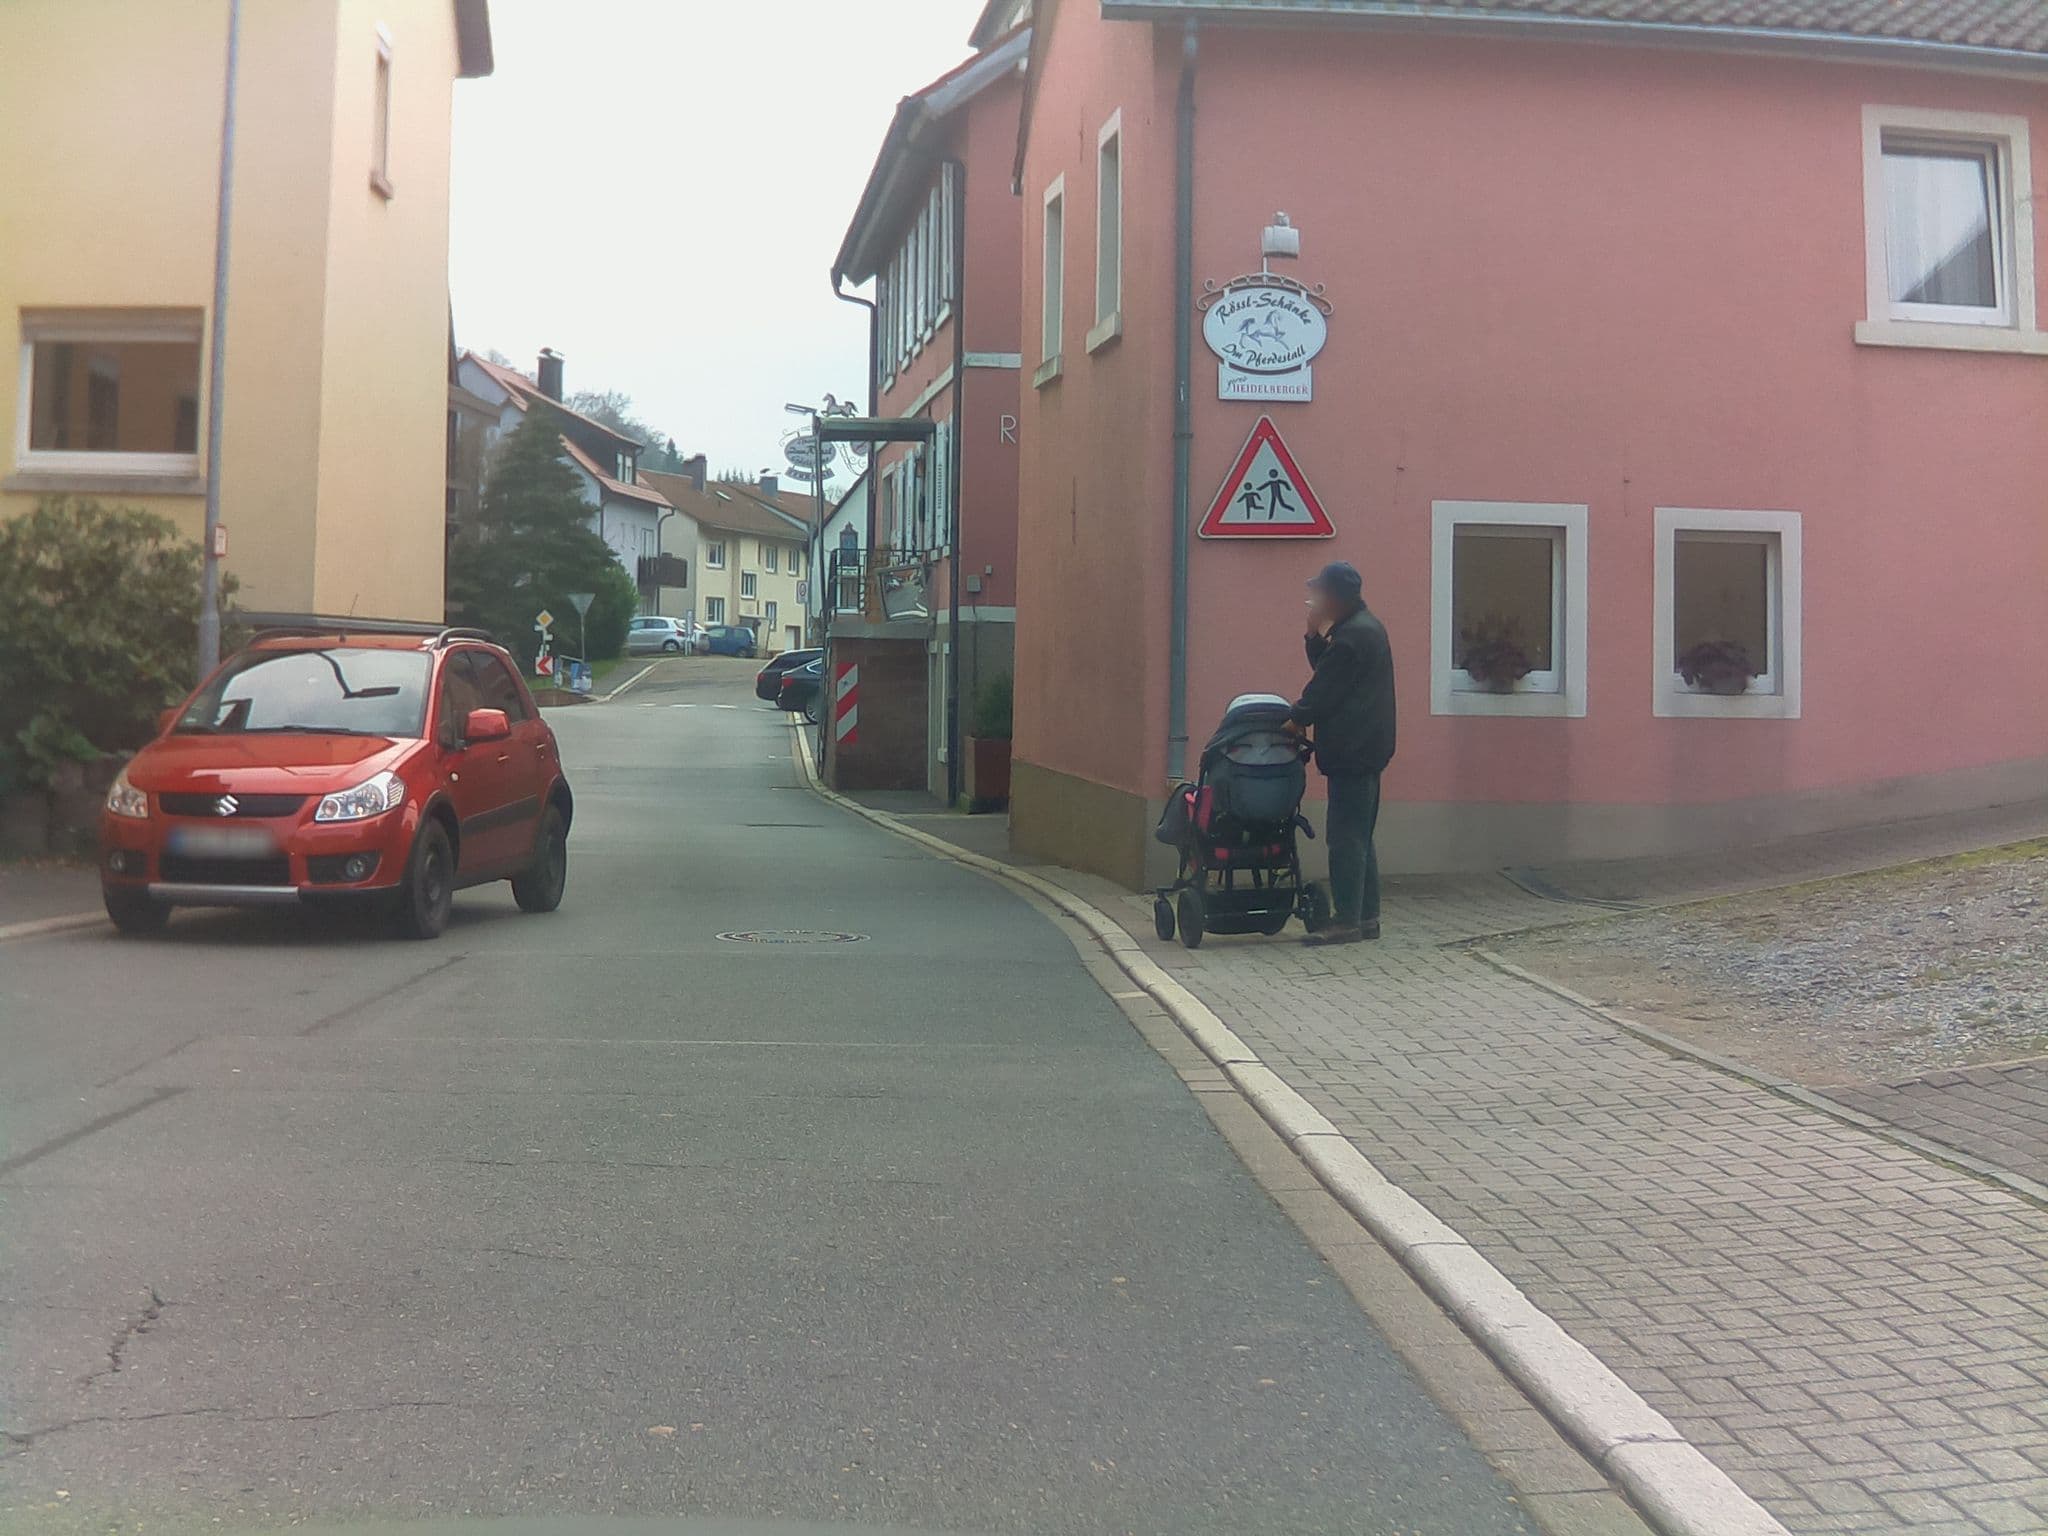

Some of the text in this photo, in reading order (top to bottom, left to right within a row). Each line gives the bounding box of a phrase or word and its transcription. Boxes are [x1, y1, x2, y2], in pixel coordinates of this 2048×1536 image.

[1215, 292, 1312, 325] Rössl-Schänke
[1246, 344, 1306, 368] Pferdestall
[1233, 383, 1309, 395] HEIDELBERGER
[1000, 414, 1017, 444] R
